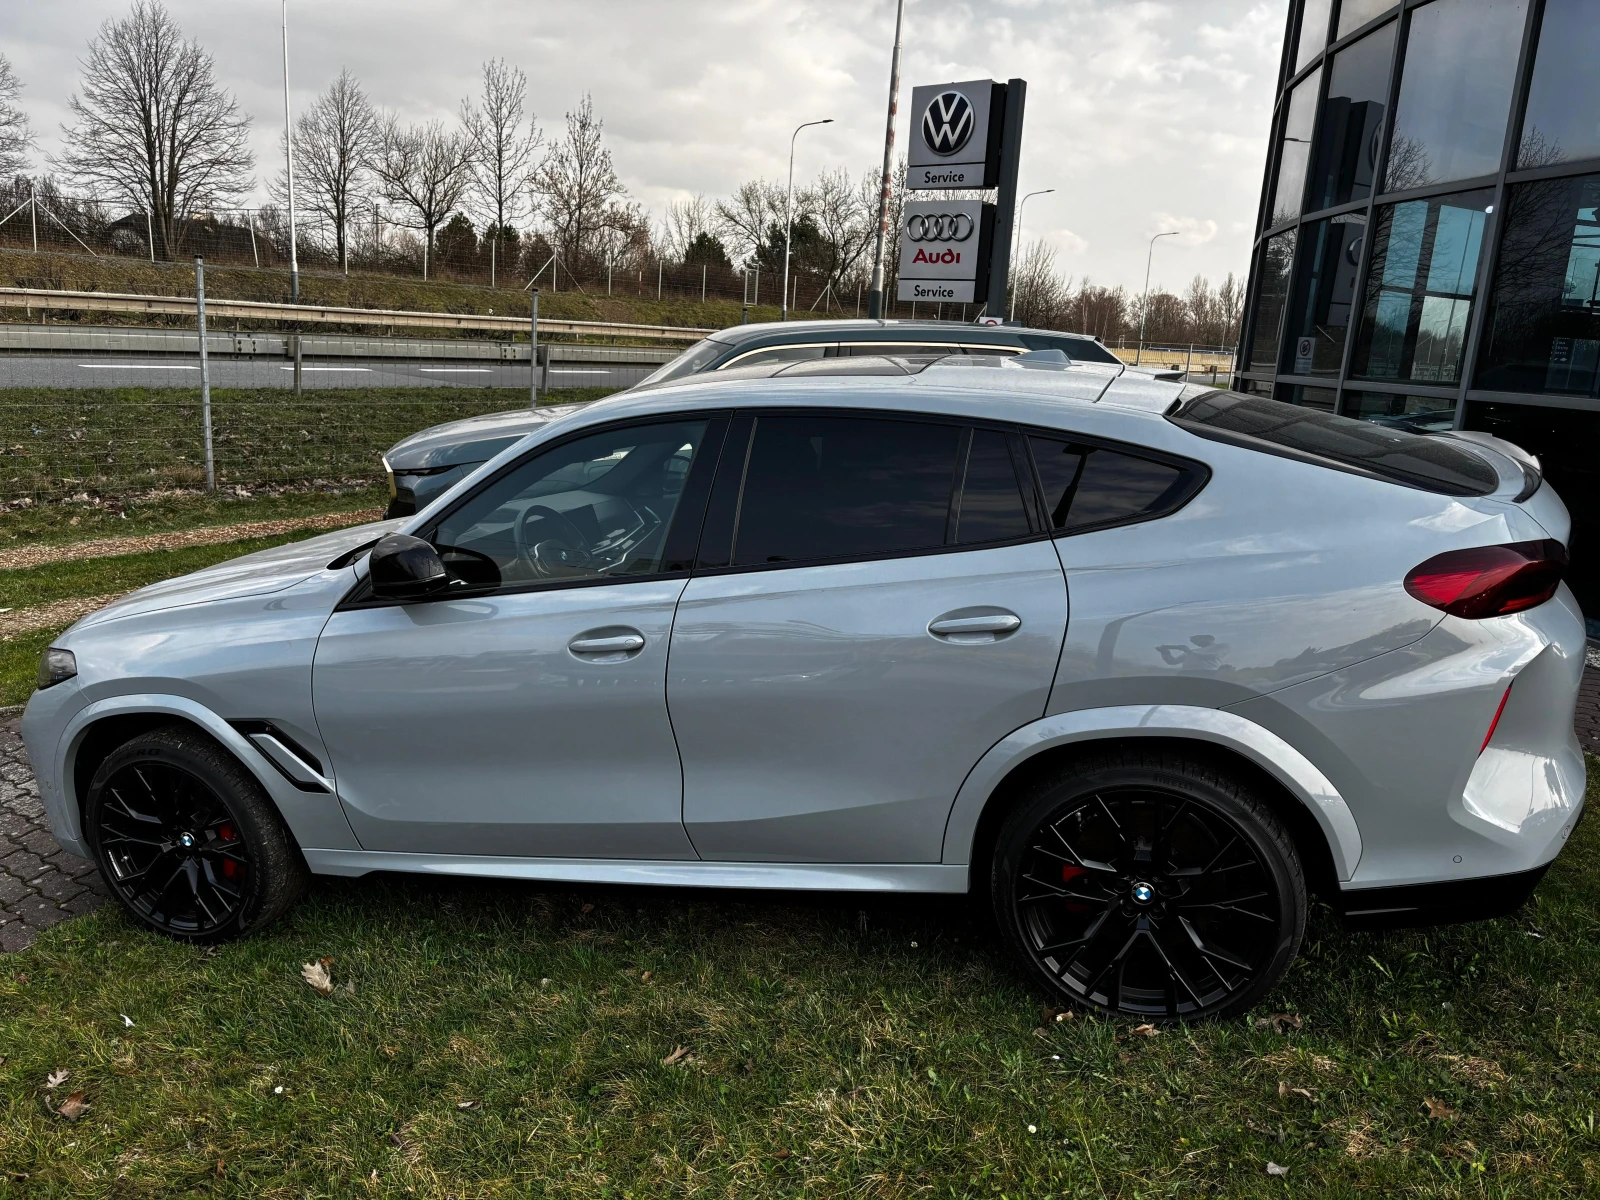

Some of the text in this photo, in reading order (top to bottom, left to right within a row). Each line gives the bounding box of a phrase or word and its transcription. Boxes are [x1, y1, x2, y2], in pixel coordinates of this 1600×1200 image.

[922, 91, 975, 156] VW
[924, 171, 965, 183] Service
[912, 249, 961, 264] Audi
[914, 284, 954, 297] Service
